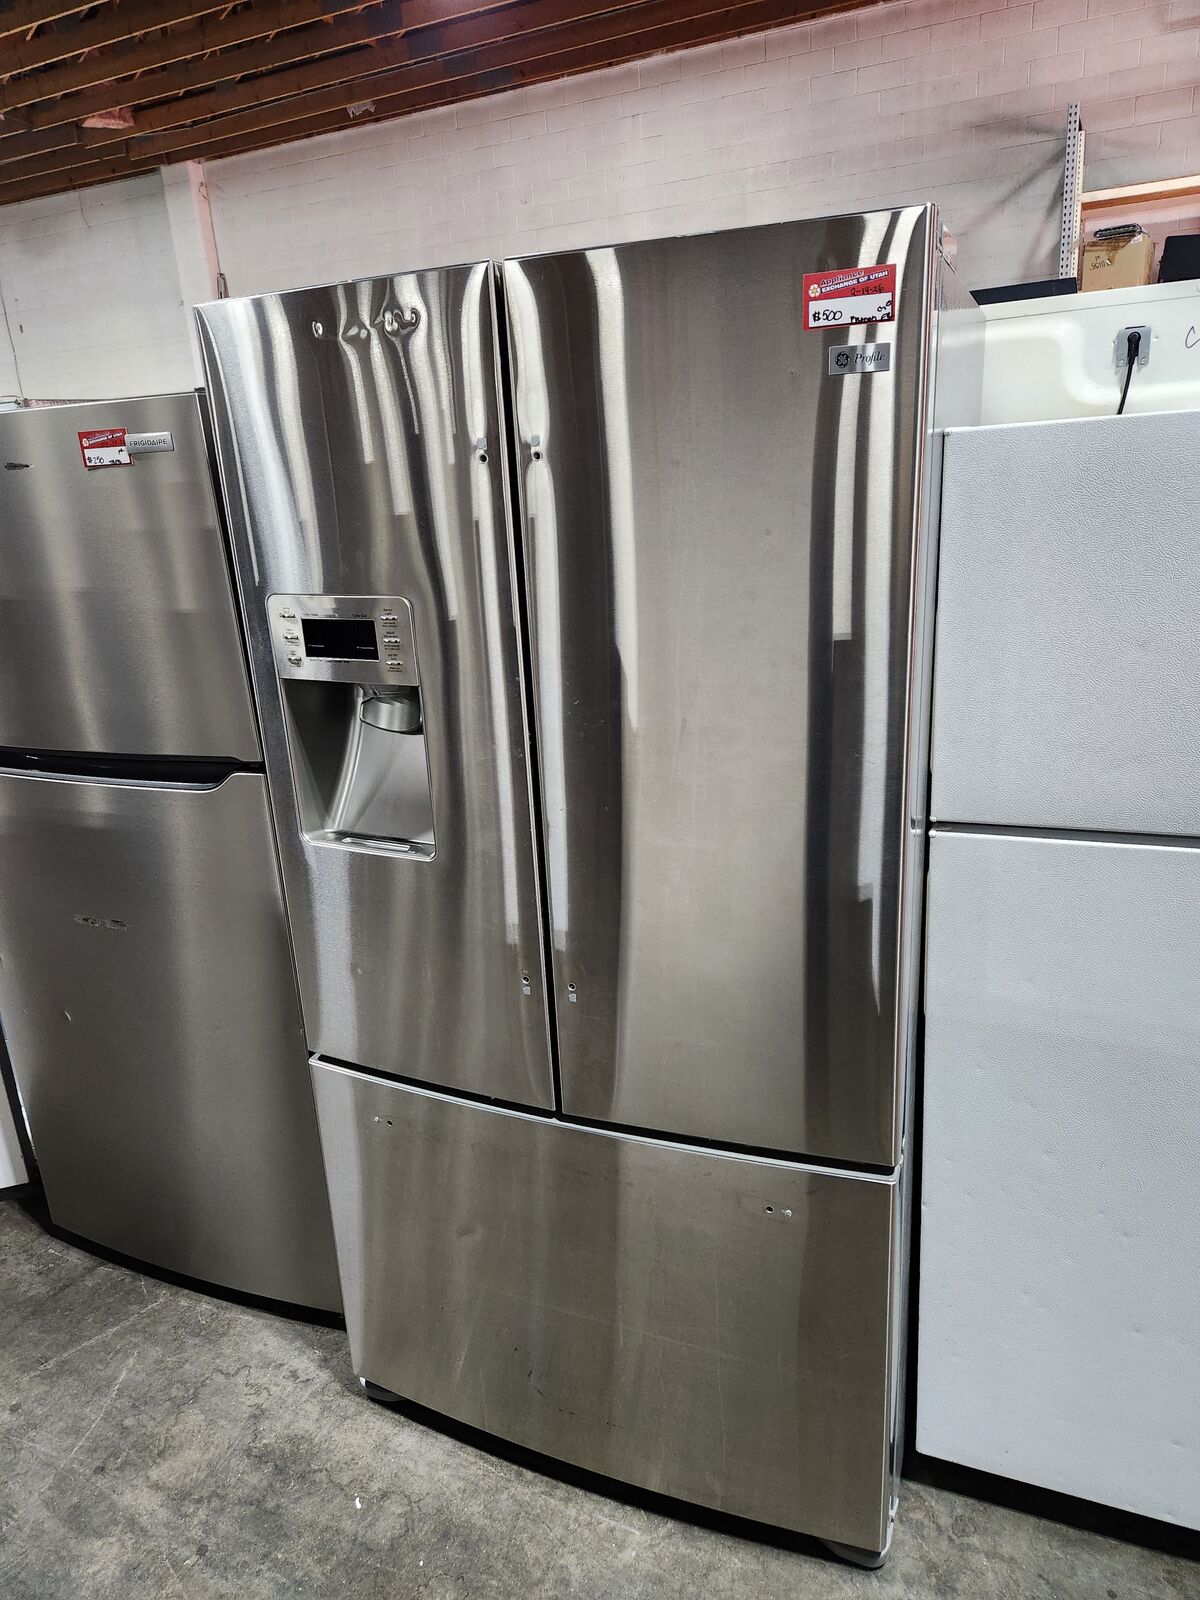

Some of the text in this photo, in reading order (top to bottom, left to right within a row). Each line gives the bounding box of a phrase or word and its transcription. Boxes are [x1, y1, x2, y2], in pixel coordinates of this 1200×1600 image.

[821, 279, 858, 293] EXCHANGE
[869, 270, 889, 280] UTAH
[812, 309, 843, 323] $500
[854, 351, 885, 365] Profile
[129, 438, 168, 447] FRIGIDAIRE
